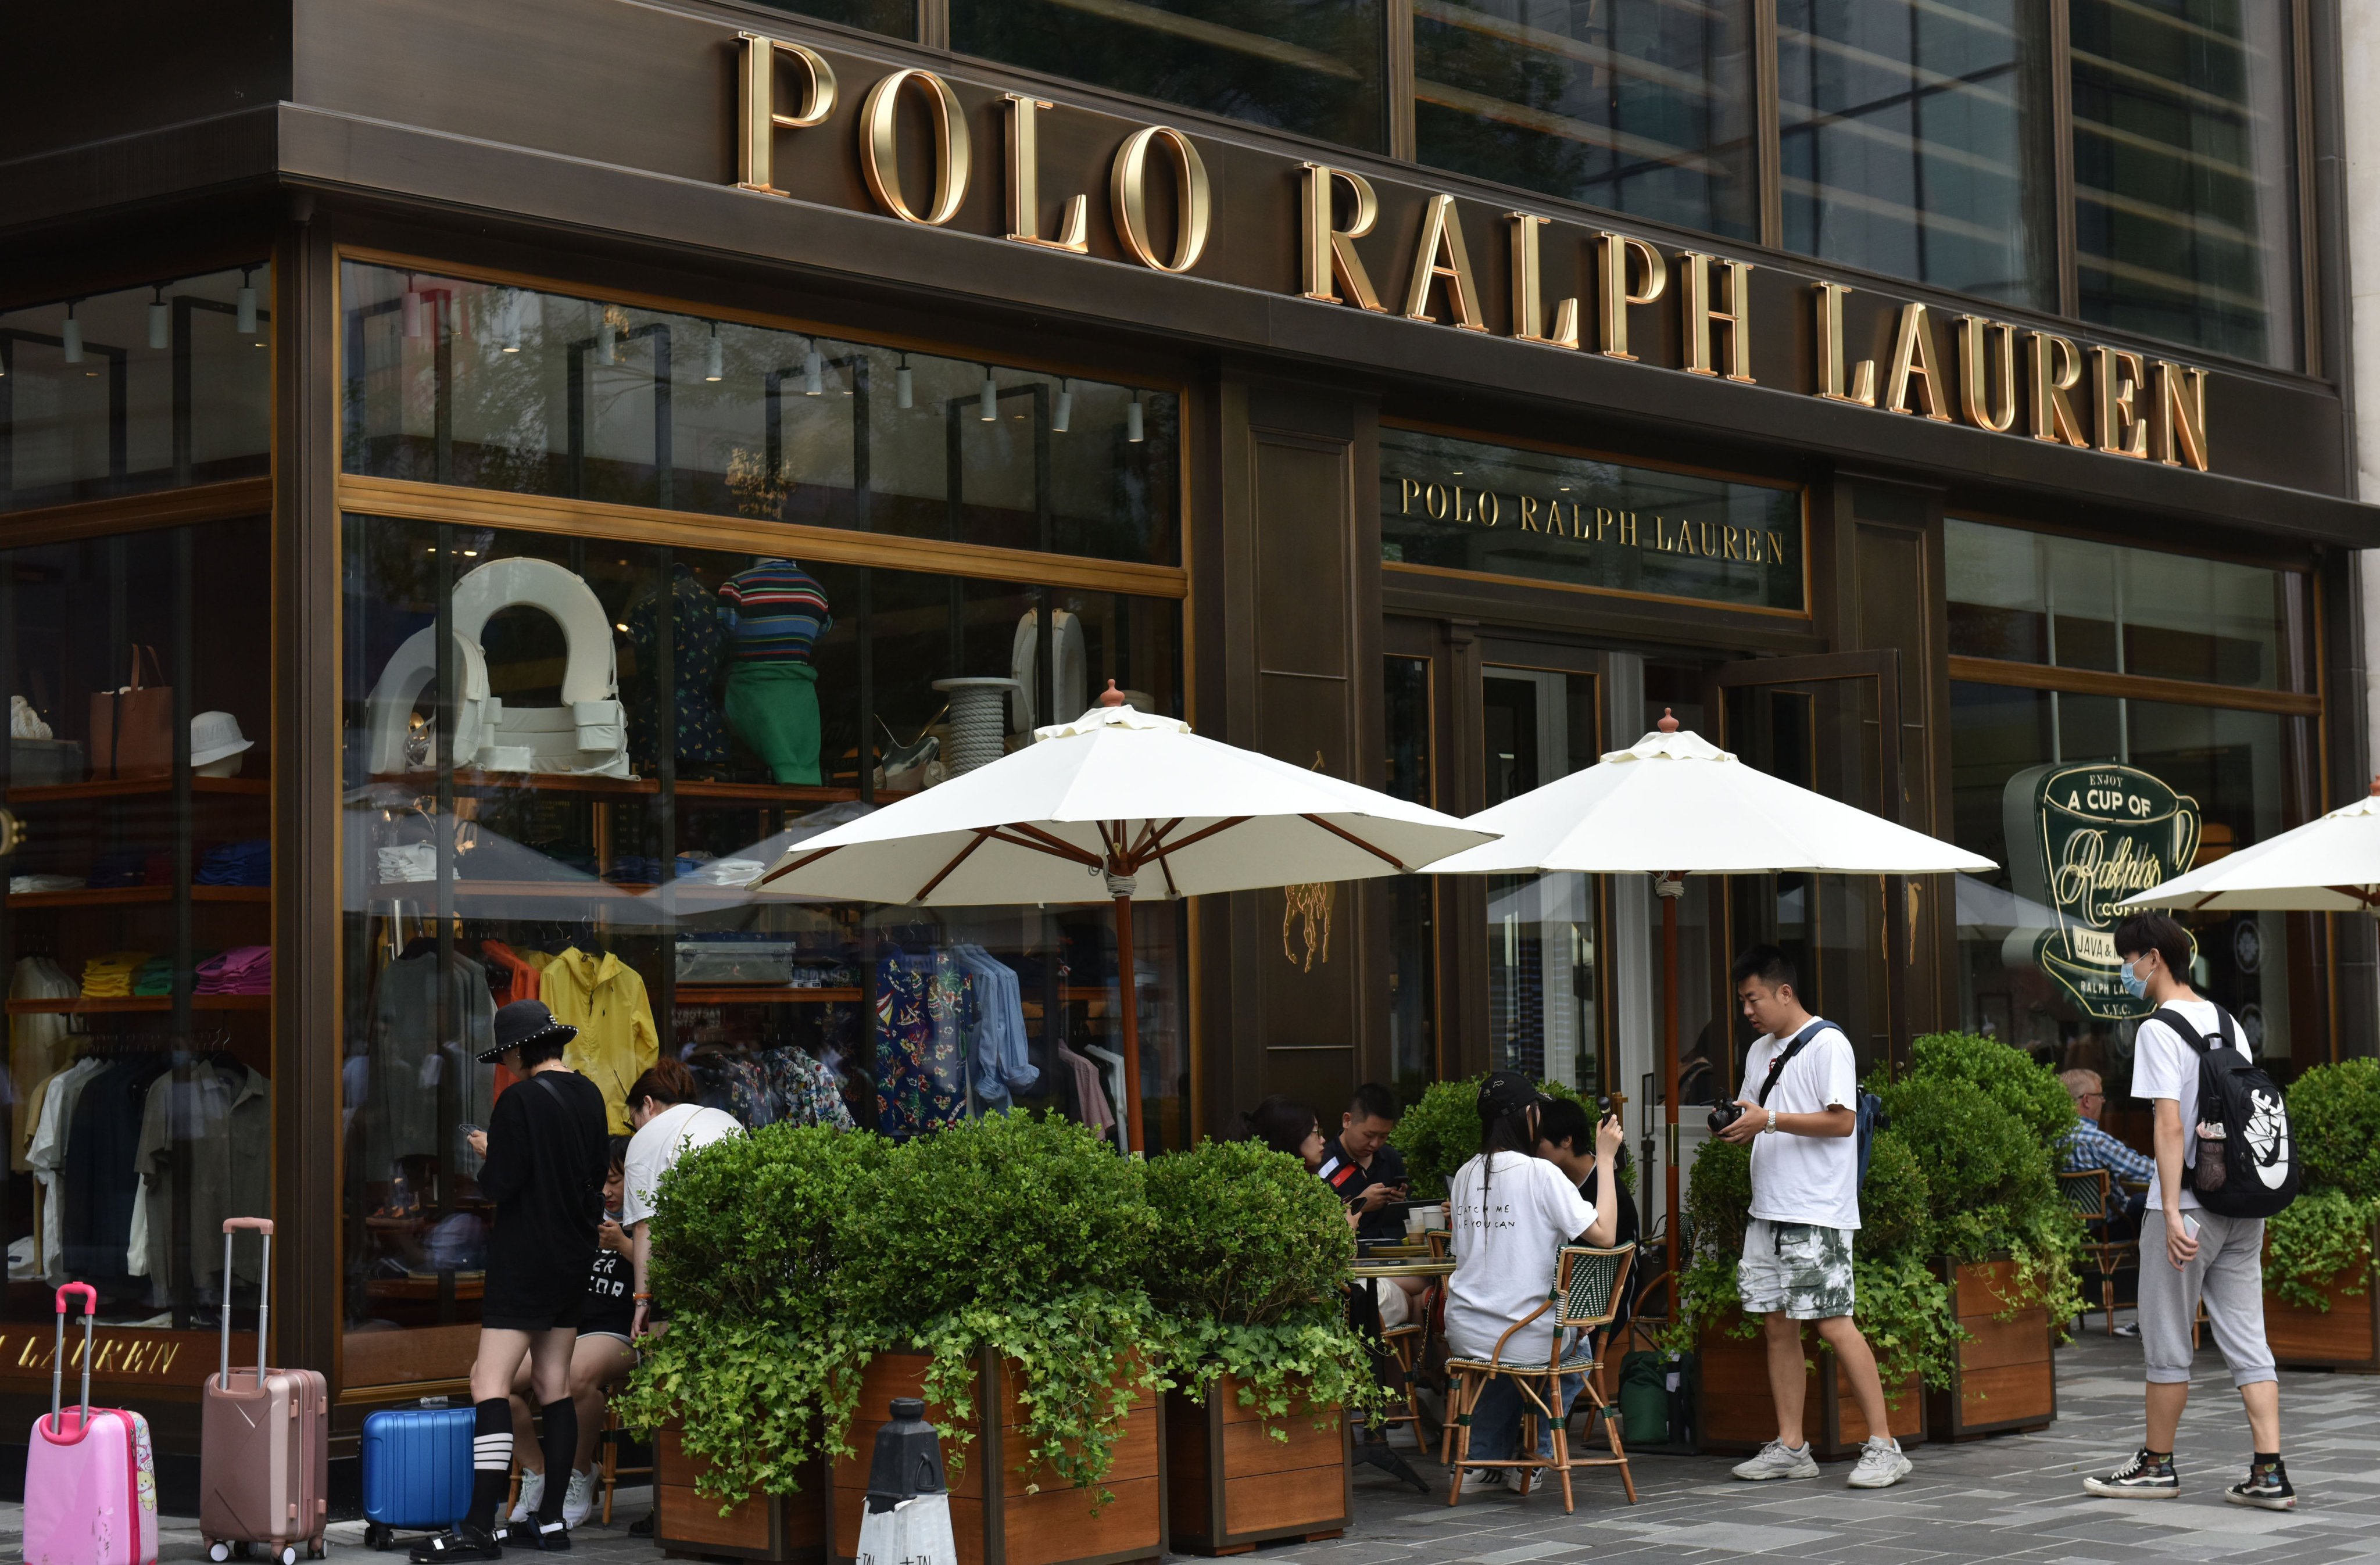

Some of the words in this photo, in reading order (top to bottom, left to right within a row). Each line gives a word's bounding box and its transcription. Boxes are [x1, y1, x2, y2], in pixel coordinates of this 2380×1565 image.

[728, 31, 1211, 274] POLO
[1293, 162, 1756, 384] RALPH
[1810, 281, 2209, 472] LAUREN
[1400, 478, 1499, 527] POLO
[1519, 495, 1638, 546] RALPH
[1655, 515, 1783, 565] LAUREN
[2089, 774, 2123, 787] ENJOY
[2067, 790, 2081, 811] A
[2087, 789, 2123, 811] CUP
[2128, 794, 2151, 818] OF
[2077, 934, 2103, 958] JAVA
[2105, 944, 2112, 958] &
[2080, 980, 2109, 995] RALPH
[2103, 1004, 2130, 1015] N.Y.C.
[1457, 1205, 1488, 1216] CATCH
[1496, 1205, 1509, 1213] ME
